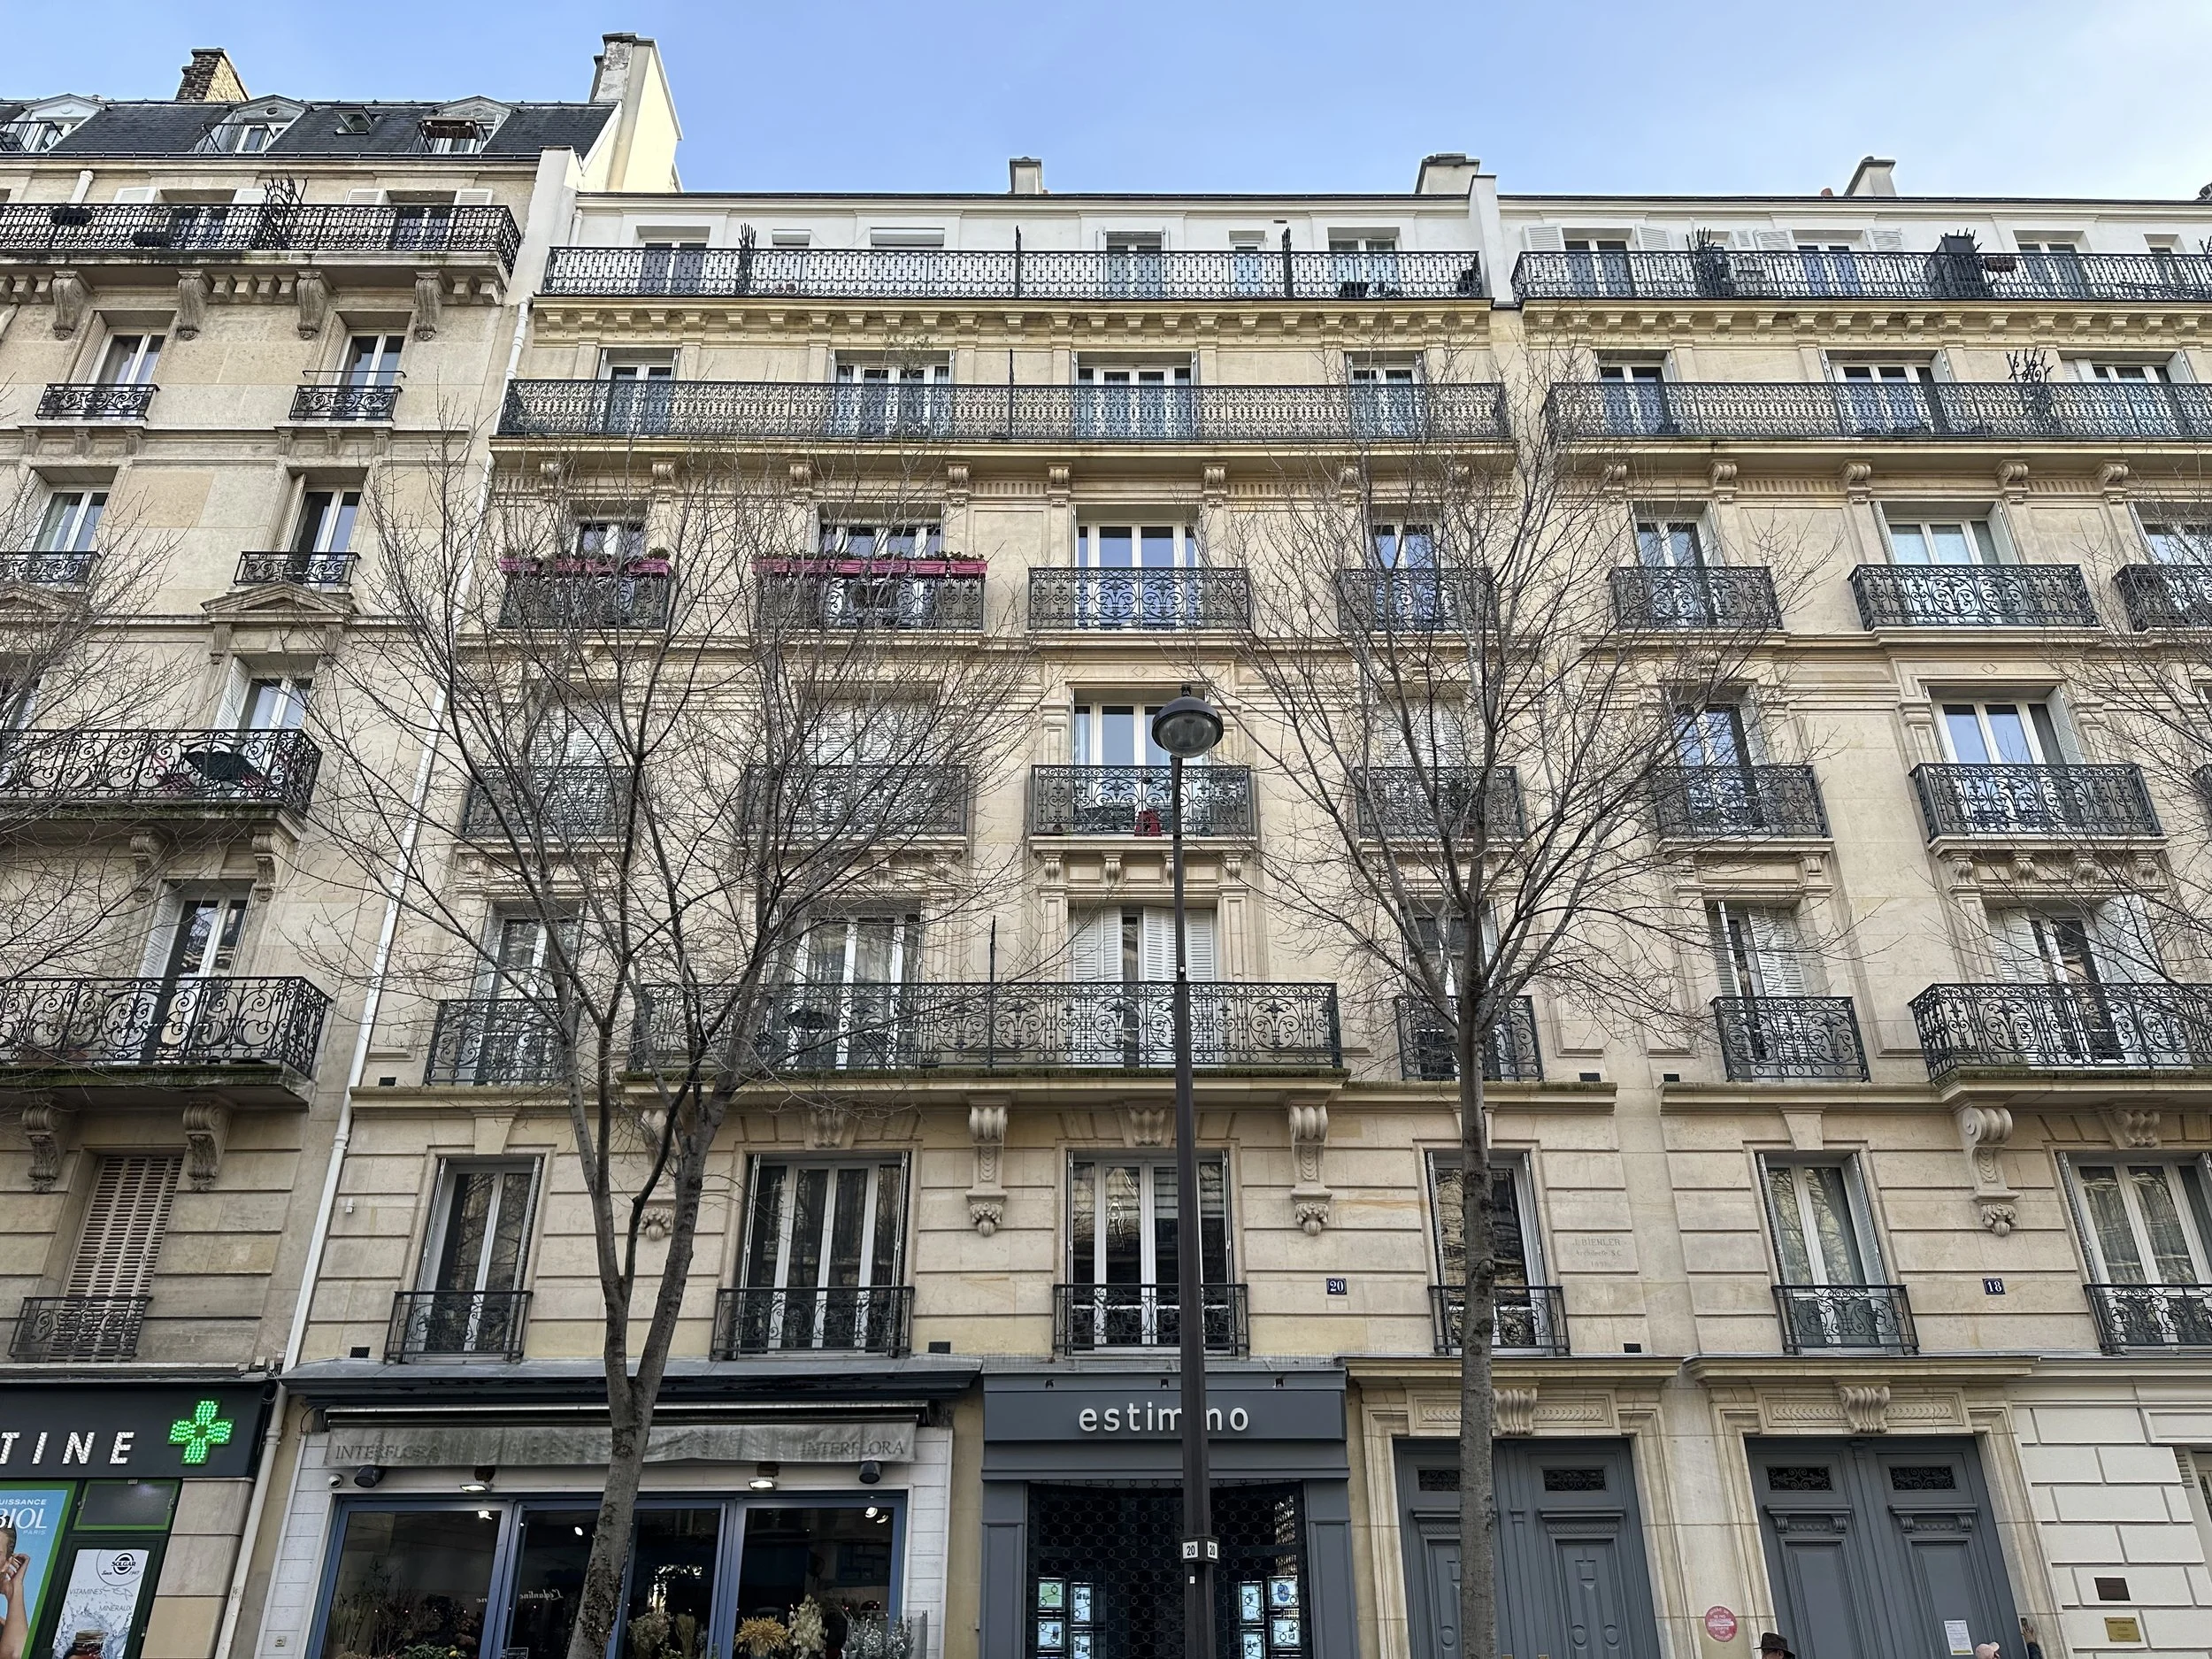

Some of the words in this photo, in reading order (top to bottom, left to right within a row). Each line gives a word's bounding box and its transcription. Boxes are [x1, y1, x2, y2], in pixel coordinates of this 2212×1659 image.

[1329, 1280, 1344, 1292] 20
[1987, 1280, 2002, 1292] 18
[0, 1432, 134, 1464] TINE
[802, 1440, 905, 1455] INTERFLORA
[0, 1507, 47, 1529] BIOL
[1187, 1545, 1195, 1556] 20
[1209, 1544, 1216, 1556] 20
